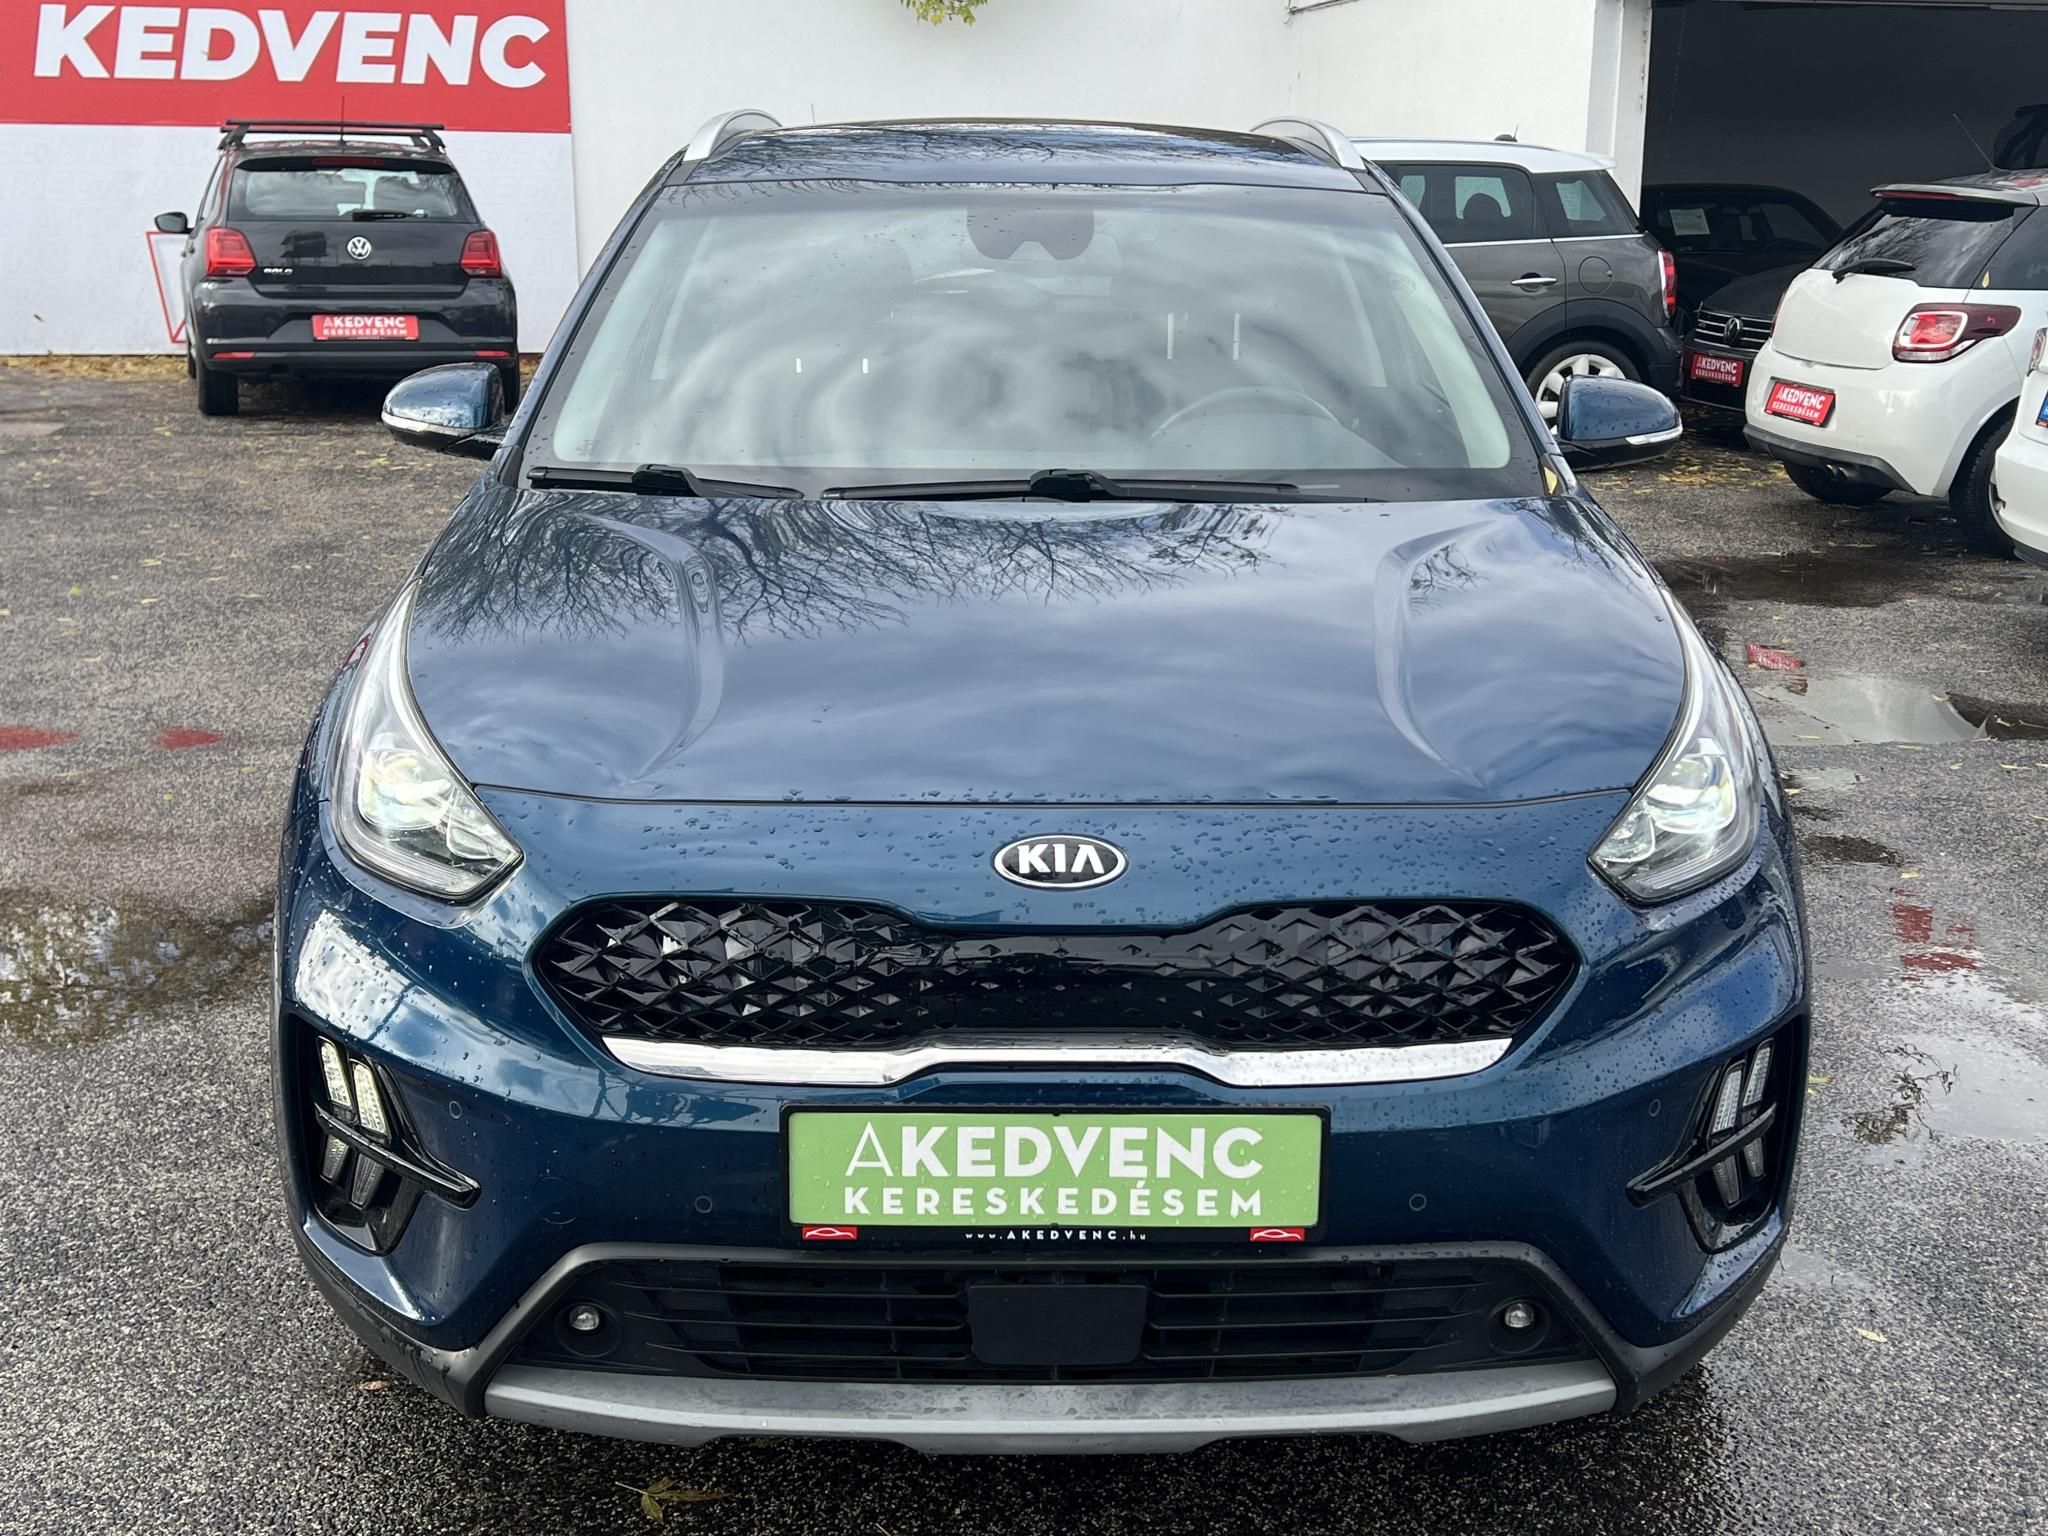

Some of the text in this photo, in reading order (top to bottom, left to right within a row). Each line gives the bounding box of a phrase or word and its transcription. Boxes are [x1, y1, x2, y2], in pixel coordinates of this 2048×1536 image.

[34, 4, 550, 88] KEDVENC
[323, 316, 406, 328] AKEDVENC
[1696, 356, 1738, 374] AKEDVENC
[1776, 385, 1825, 409] AKEDVENC
[1017, 843, 1105, 874] KIA
[845, 1121, 1264, 1178] AKEDVENC
[844, 1180, 1262, 1217] KERESKEDÉSEM
[965, 1230, 1146, 1240] www.AKEDVENC.hu
